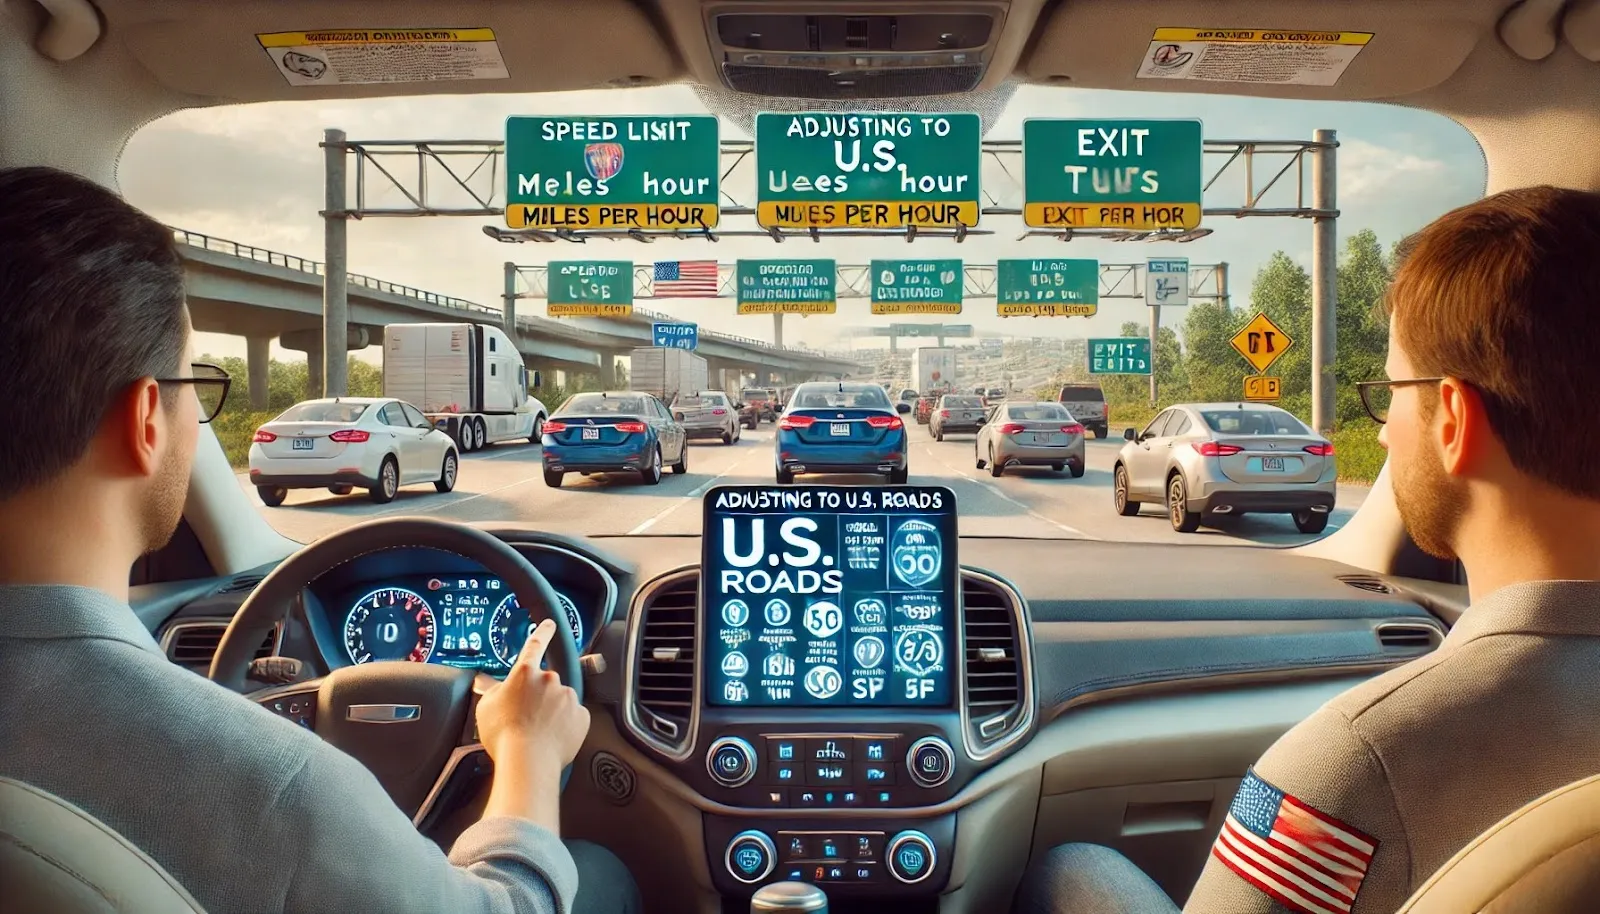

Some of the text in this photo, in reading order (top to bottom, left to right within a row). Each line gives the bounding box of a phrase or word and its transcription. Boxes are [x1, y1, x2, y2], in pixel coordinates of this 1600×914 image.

[541, 121, 618, 141] SPEED
[786, 117, 951, 137] ADJUSTING TO
[1078, 128, 1149, 157] EXIT
[643, 171, 709, 195] hour
[901, 166, 968, 193] hour
[523, 206, 707, 227] MILES PER HOUR
[846, 204, 887, 224] PER
[899, 204, 960, 224] HOUR
[817, 492, 841, 509] TO
[882, 491, 943, 509] ROADS
[722, 517, 834, 568] U.S.
[720, 569, 844, 594] ROADS
